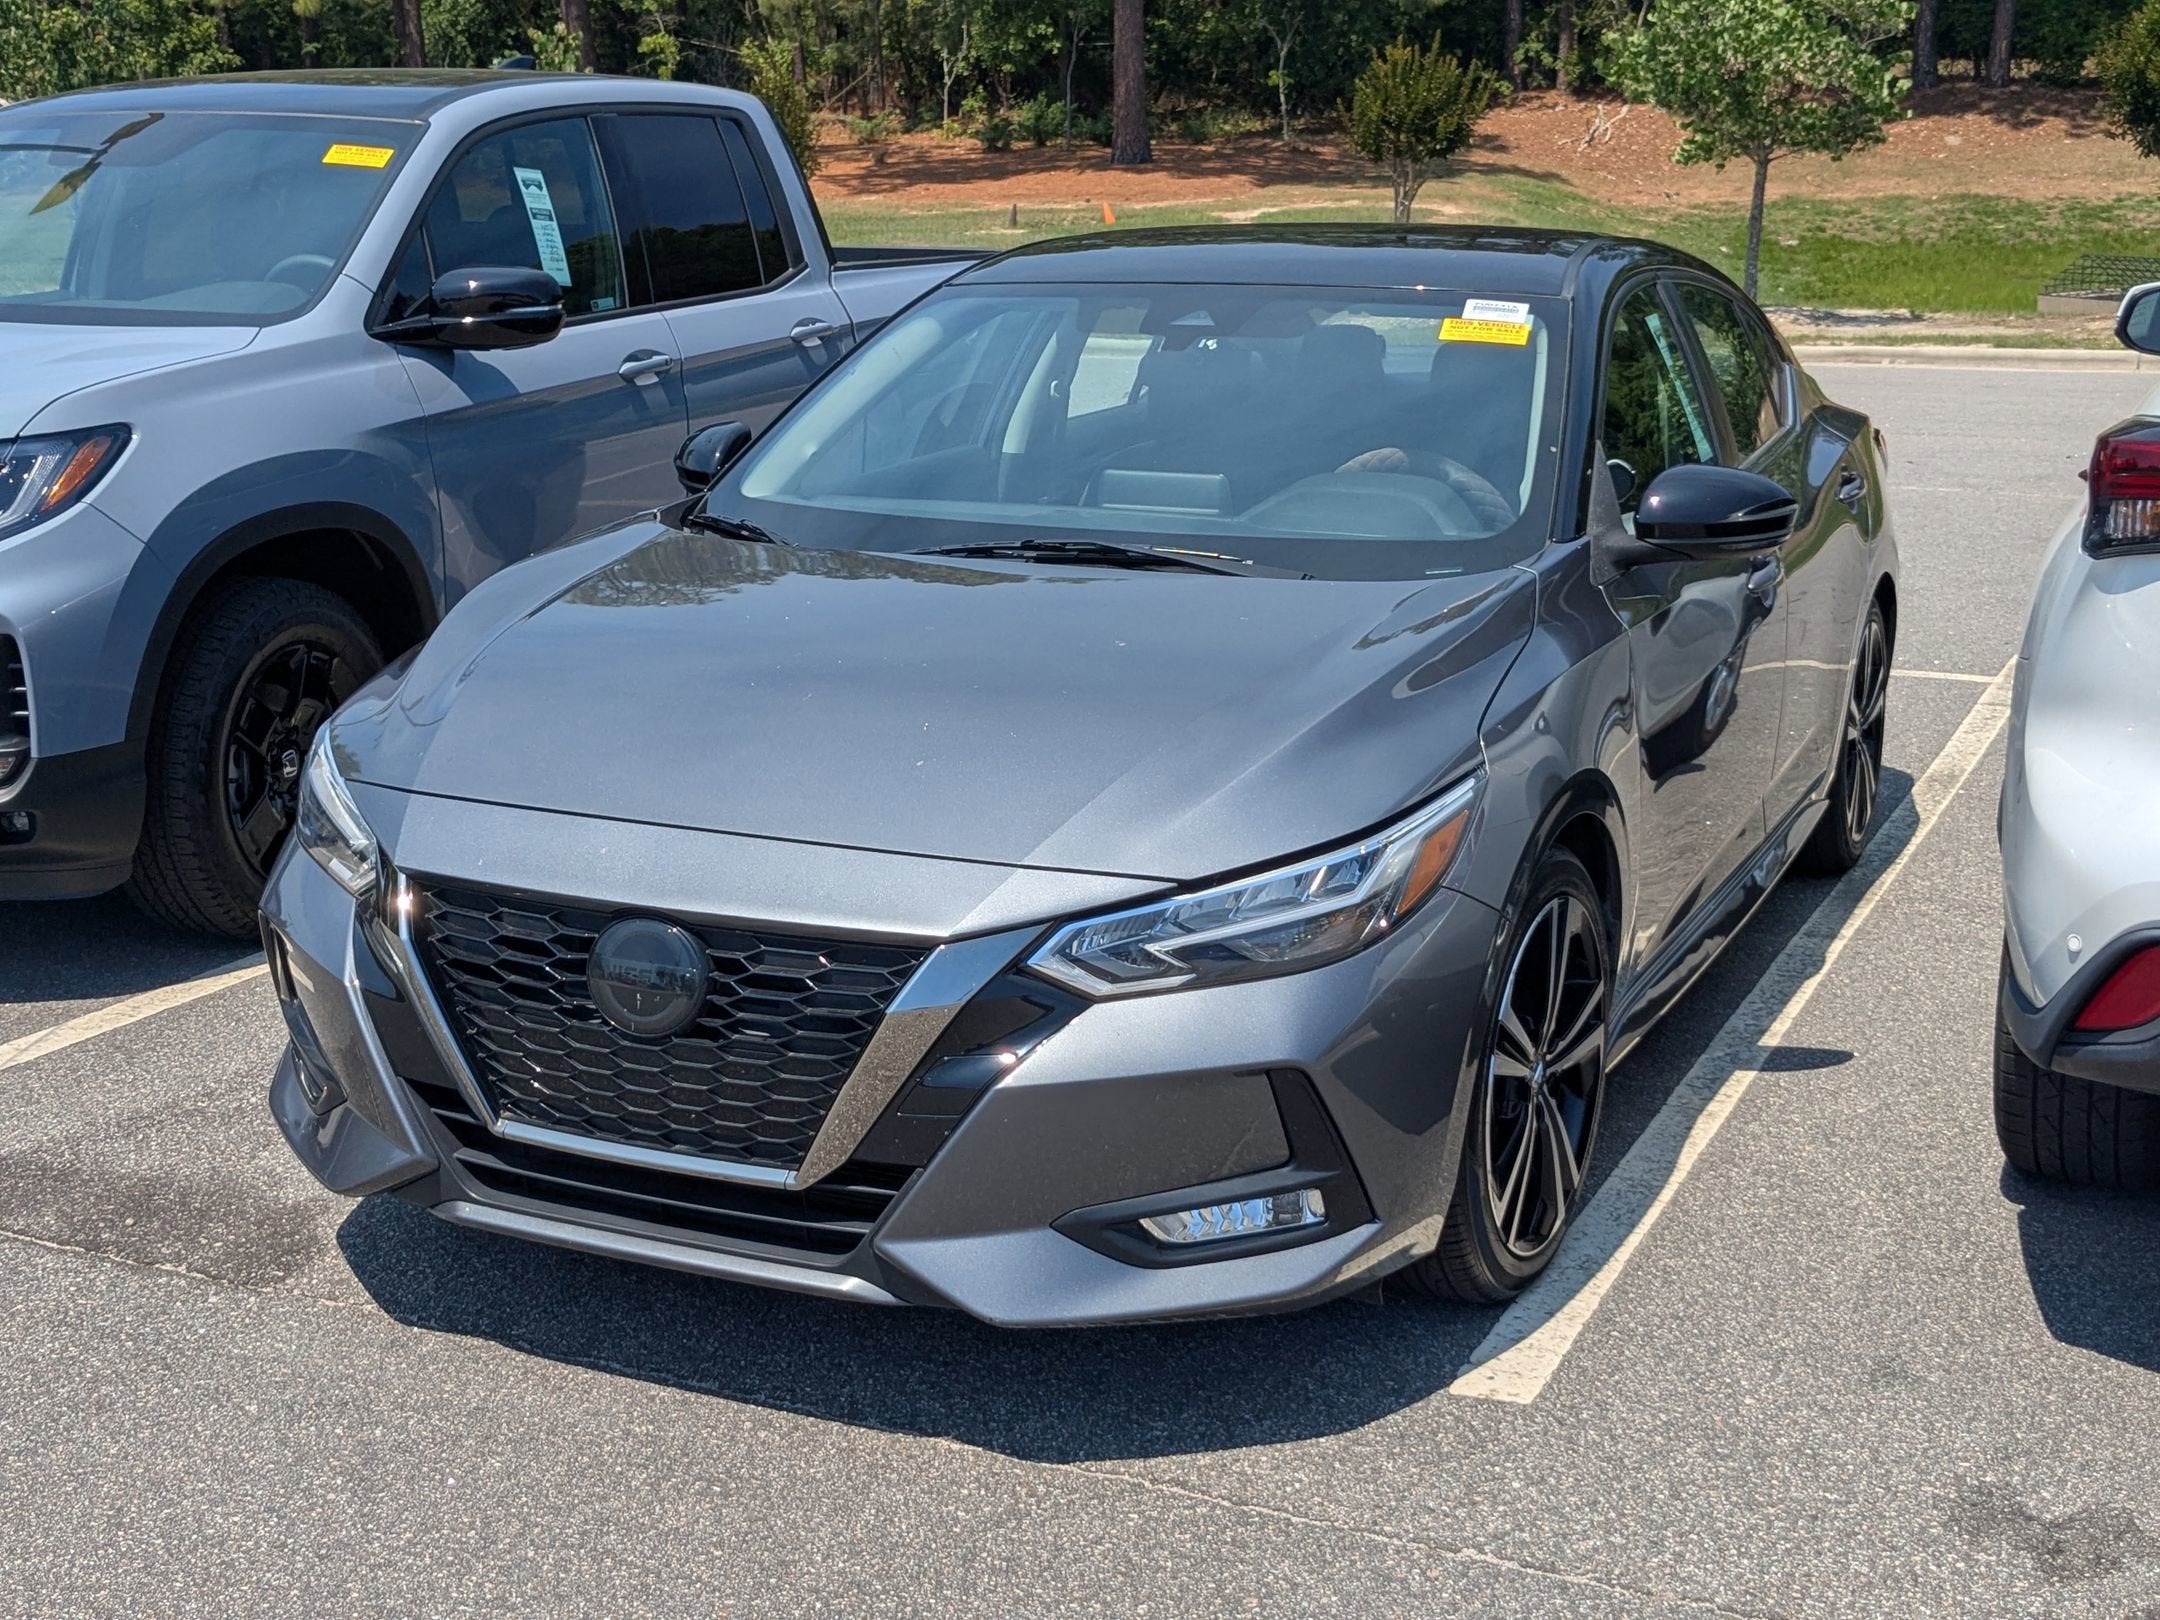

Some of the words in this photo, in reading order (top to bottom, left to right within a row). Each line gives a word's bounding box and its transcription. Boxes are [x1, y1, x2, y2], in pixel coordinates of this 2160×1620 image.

[355, 147, 388, 155] VEHICLE
[1449, 319, 1474, 327] THIS
[1477, 321, 1526, 330] VEHICLE
